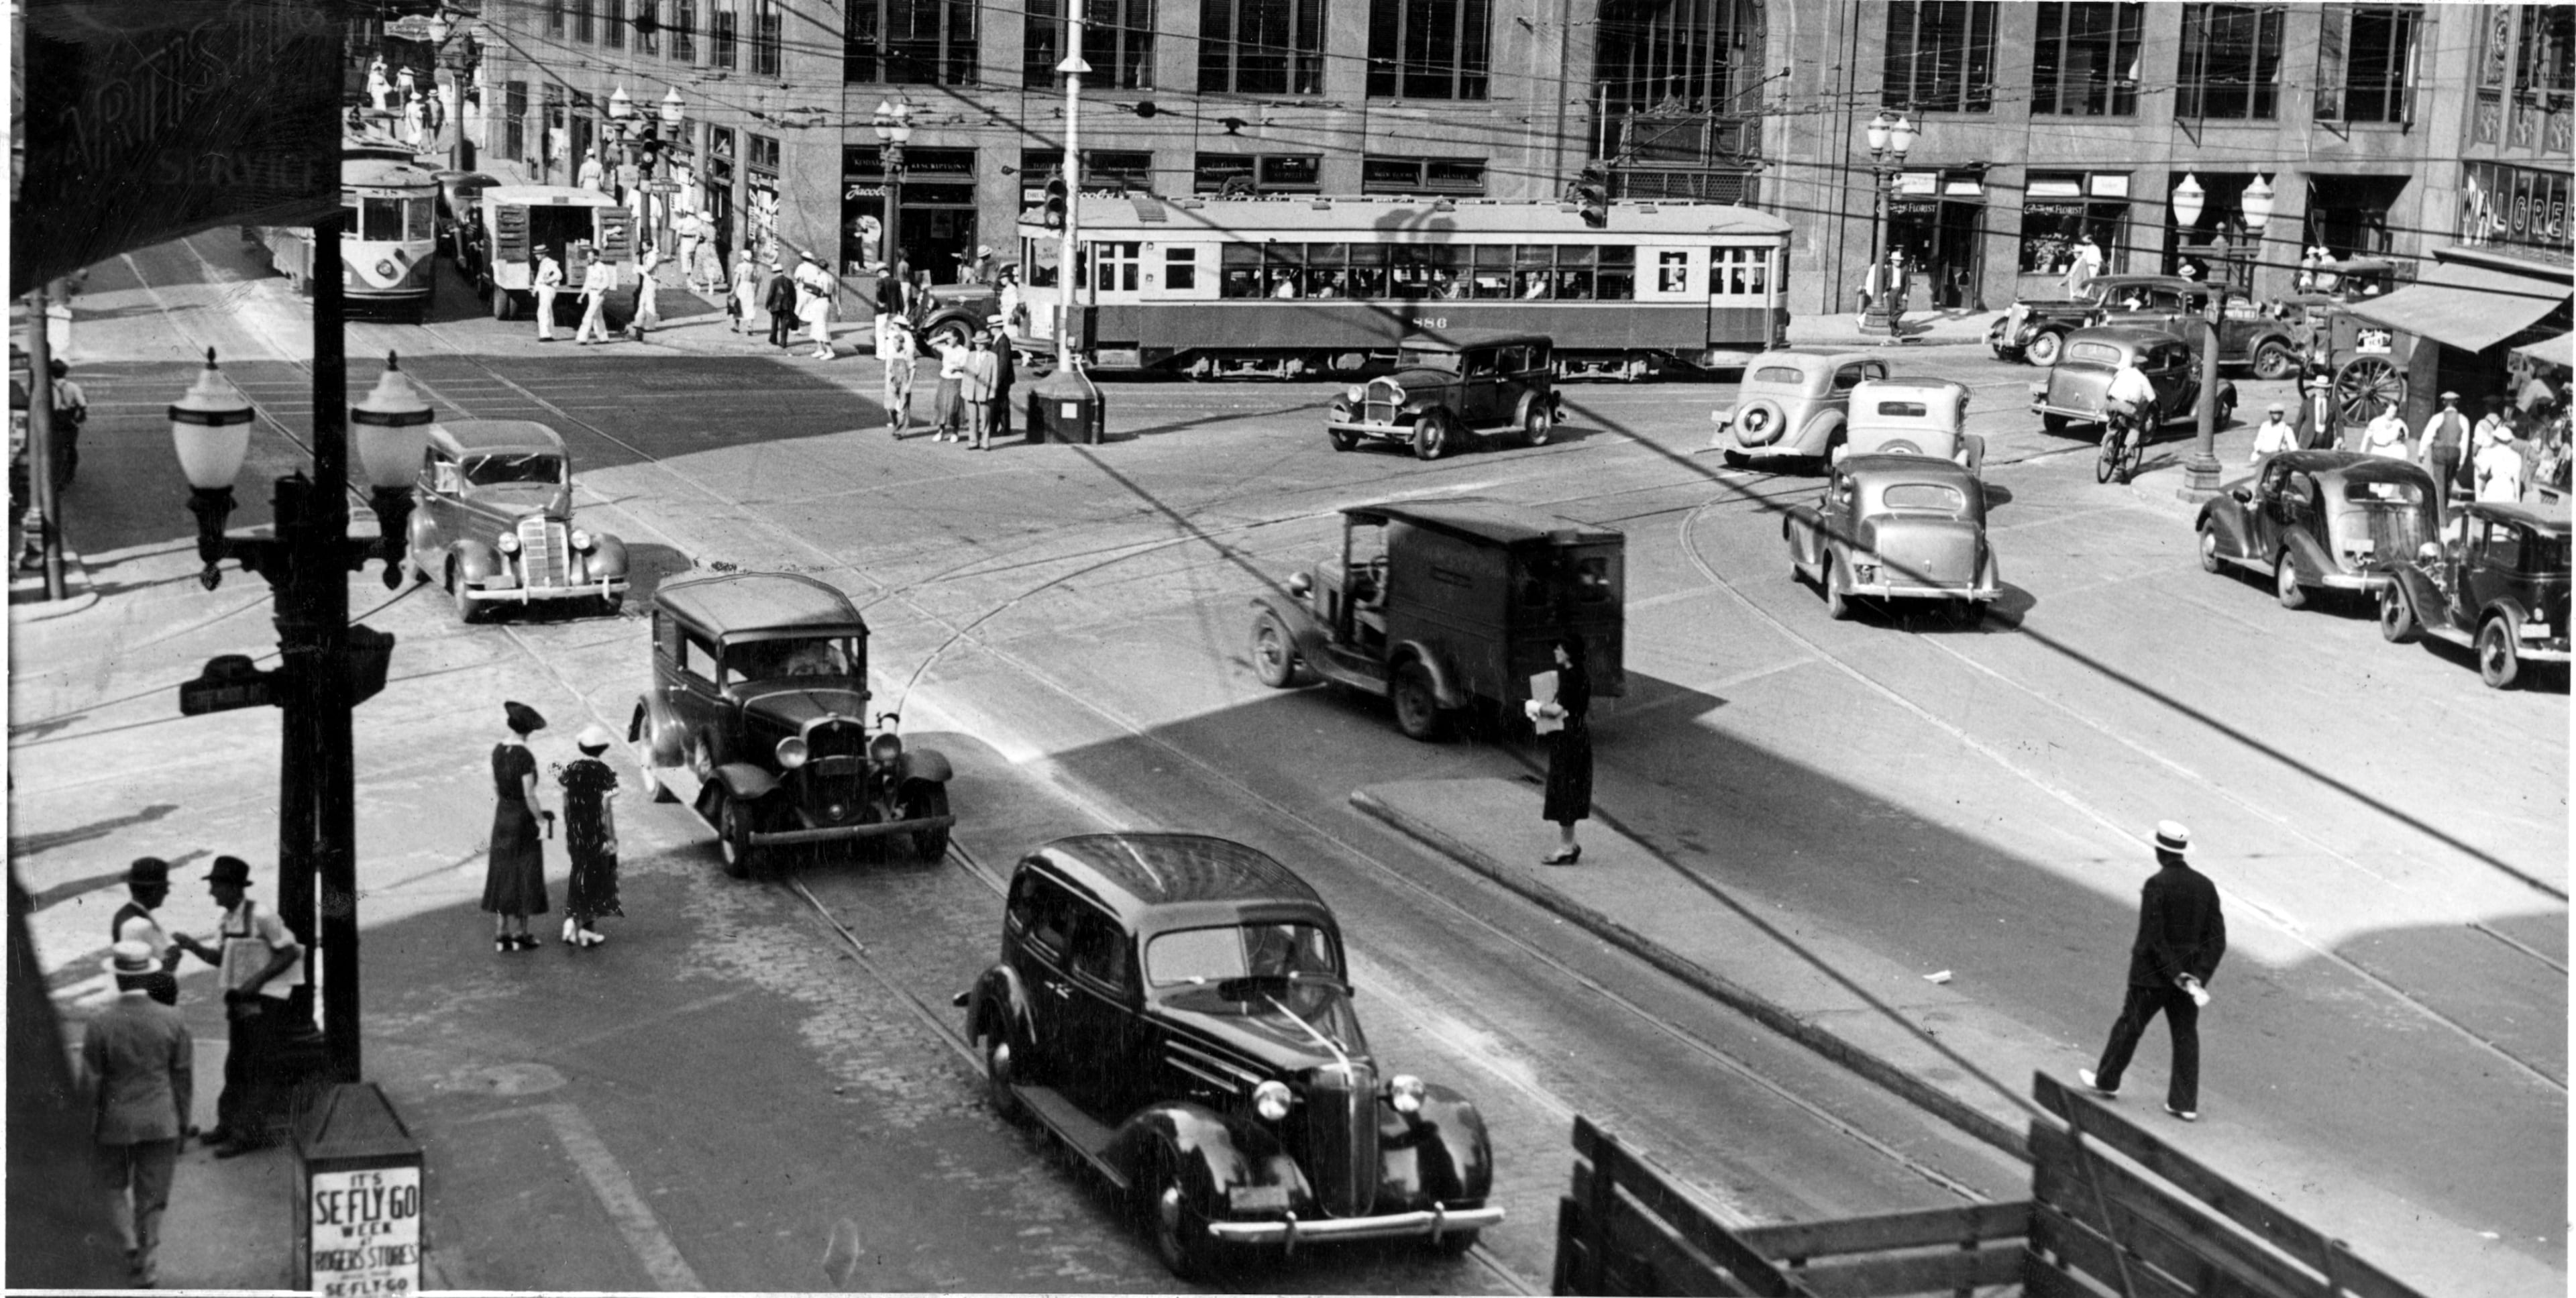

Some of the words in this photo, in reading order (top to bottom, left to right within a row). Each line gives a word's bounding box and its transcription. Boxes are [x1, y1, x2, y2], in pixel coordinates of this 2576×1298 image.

[845, 184, 886, 200] Jacob
[1908, 203, 1937, 213] FLORIST
[2055, 205, 2084, 215] FLORIST
[351, 1173, 382, 1187] IT'S
[341, 1222, 391, 1237] WEEK
